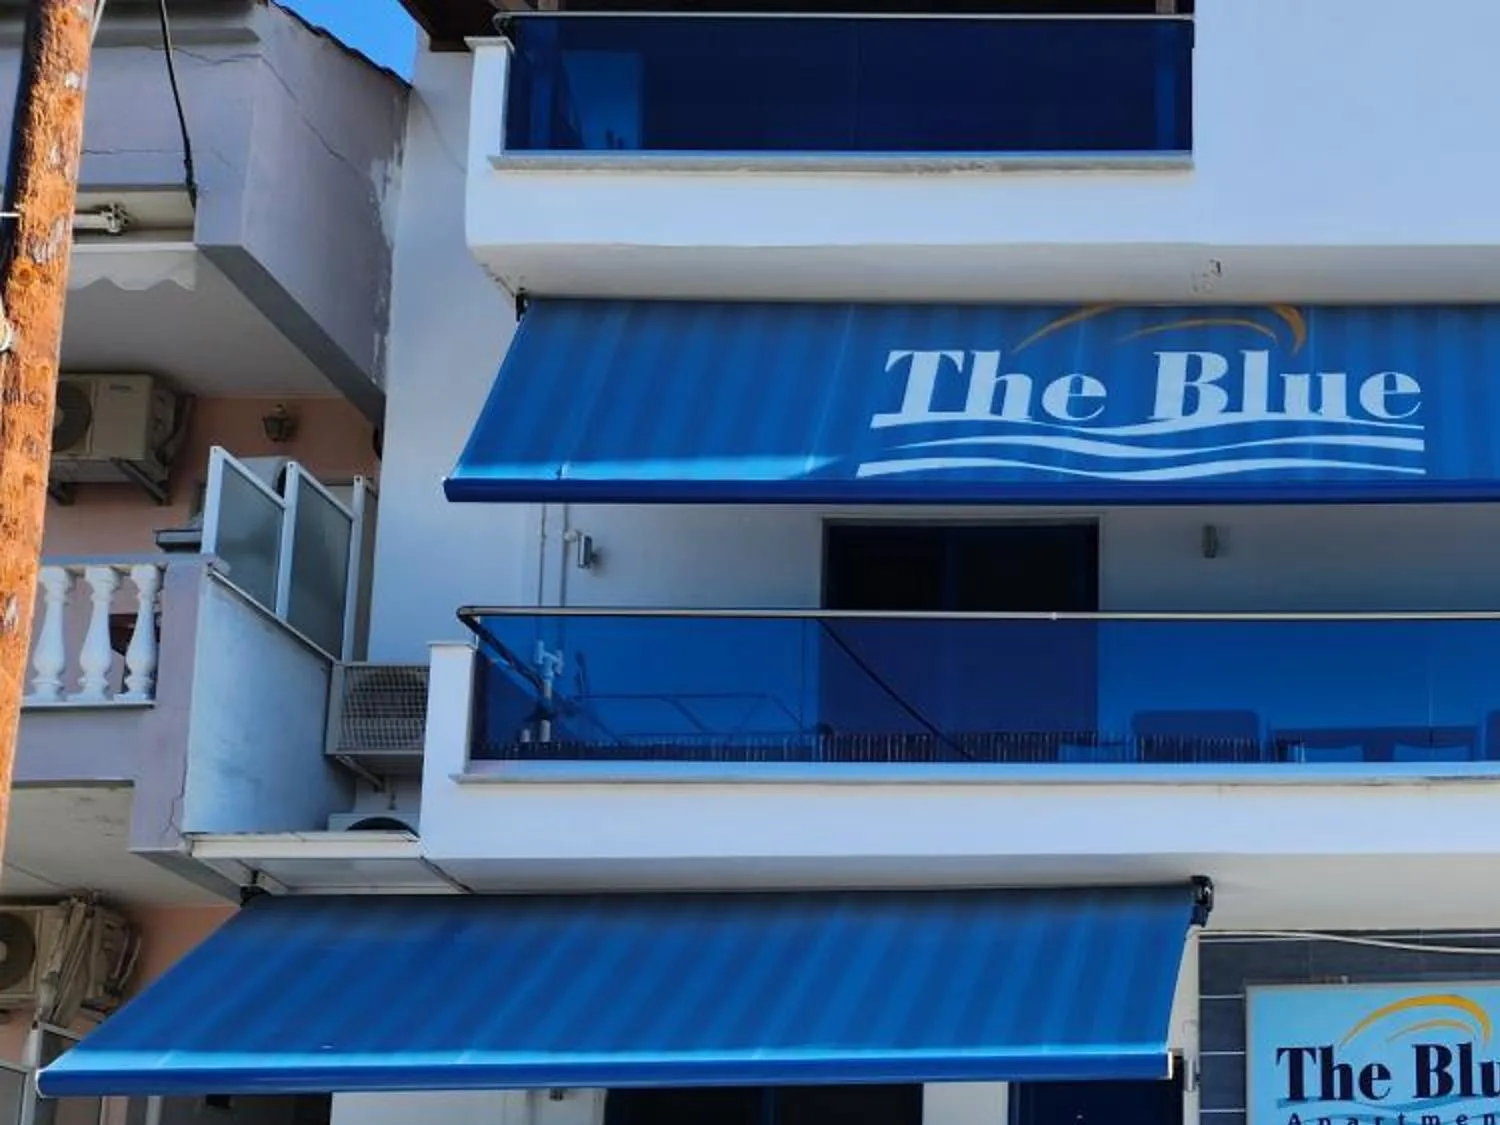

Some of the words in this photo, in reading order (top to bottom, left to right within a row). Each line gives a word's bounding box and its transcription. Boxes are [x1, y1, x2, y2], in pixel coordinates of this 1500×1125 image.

[886, 349, 1108, 421] The
[1149, 349, 1423, 421] Blue
[1275, 1045, 1393, 1101] The
